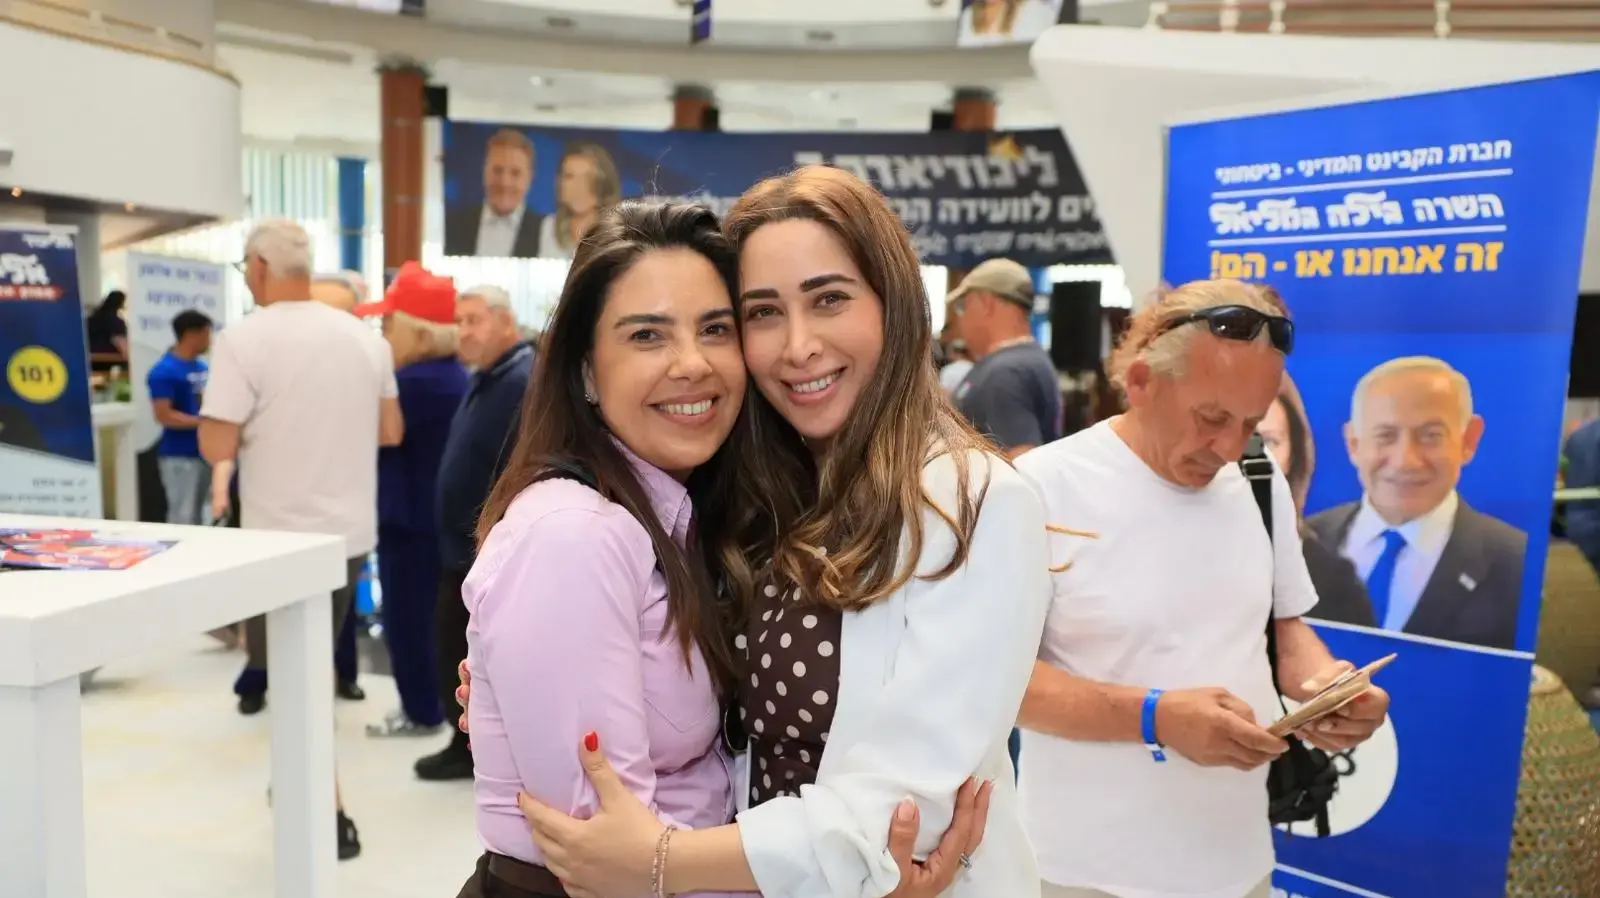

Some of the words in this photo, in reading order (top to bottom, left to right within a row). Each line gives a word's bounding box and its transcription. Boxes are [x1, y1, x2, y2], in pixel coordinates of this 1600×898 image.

[1298, 153, 1362, 177] המדיני
[1366, 146, 1443, 171] הקבינט
[1448, 139, 1512, 163] חברת
[937, 190, 1051, 225] לוועידה
[1209, 198, 1320, 234] גמליאל
[1326, 190, 1403, 228] גילה
[1413, 193, 1504, 222] השרה
[1210, 250, 1267, 280] הם!
[1294, 249, 1334, 278] או
[1342, 244, 1446, 276] אנחנו
[1454, 241, 1504, 272] זה
[18, 365, 54, 384] 101
